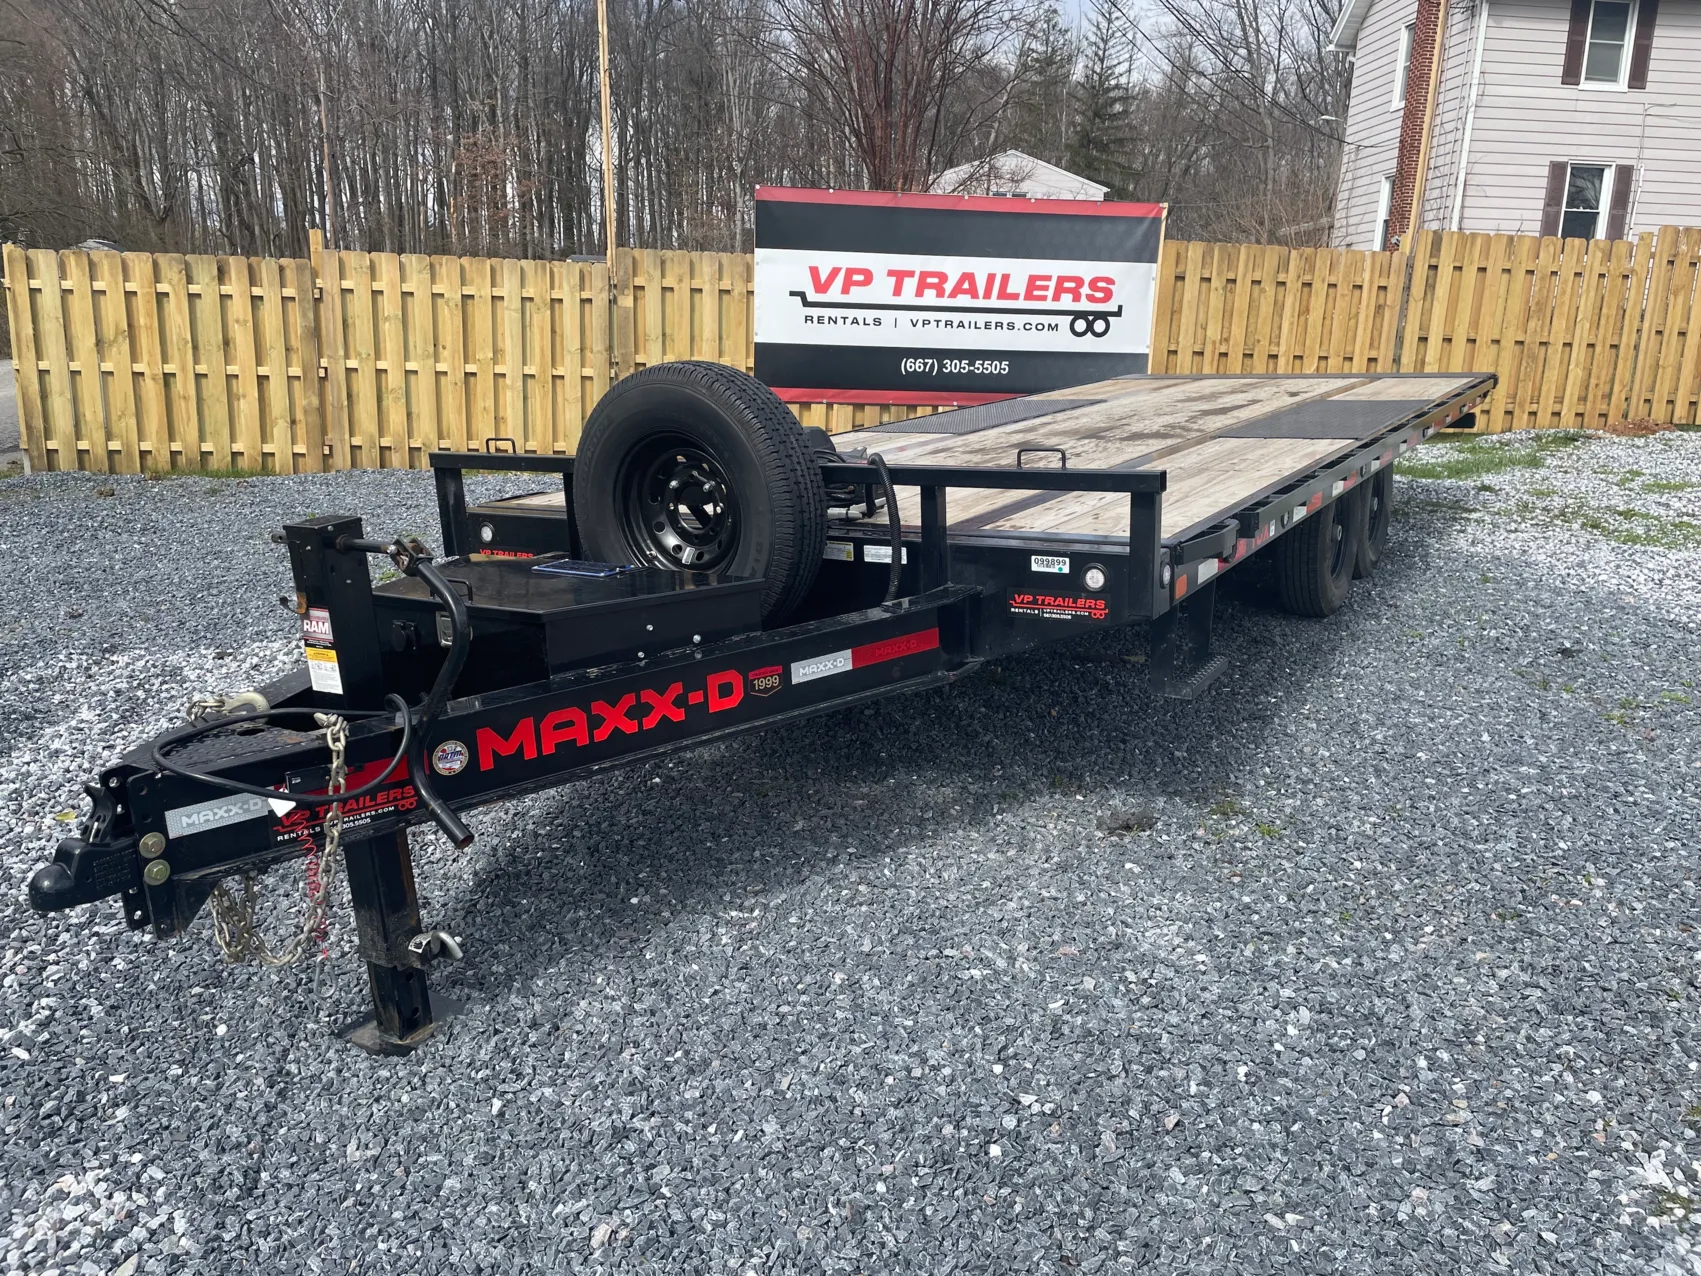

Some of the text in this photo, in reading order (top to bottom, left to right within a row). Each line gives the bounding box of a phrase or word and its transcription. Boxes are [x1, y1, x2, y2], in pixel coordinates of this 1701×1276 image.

[808, 266, 1116, 304] VP TRAILERS
[804, 315, 1059, 332] RENTALS VPTRAILERS.COM
[900, 358, 1009, 375] (667) 305-5505
[1033, 557, 1067, 566] 099899
[1014, 594, 1105, 608] VP TRAILERS
[303, 620, 329, 634] RAM
[799, 657, 845, 677] MAXX-D
[753, 675, 780, 690] 1999
[476, 668, 744, 771] MAXX-D
[181, 798, 263, 828] MAXX-D
[277, 827, 321, 842] RENTALS
